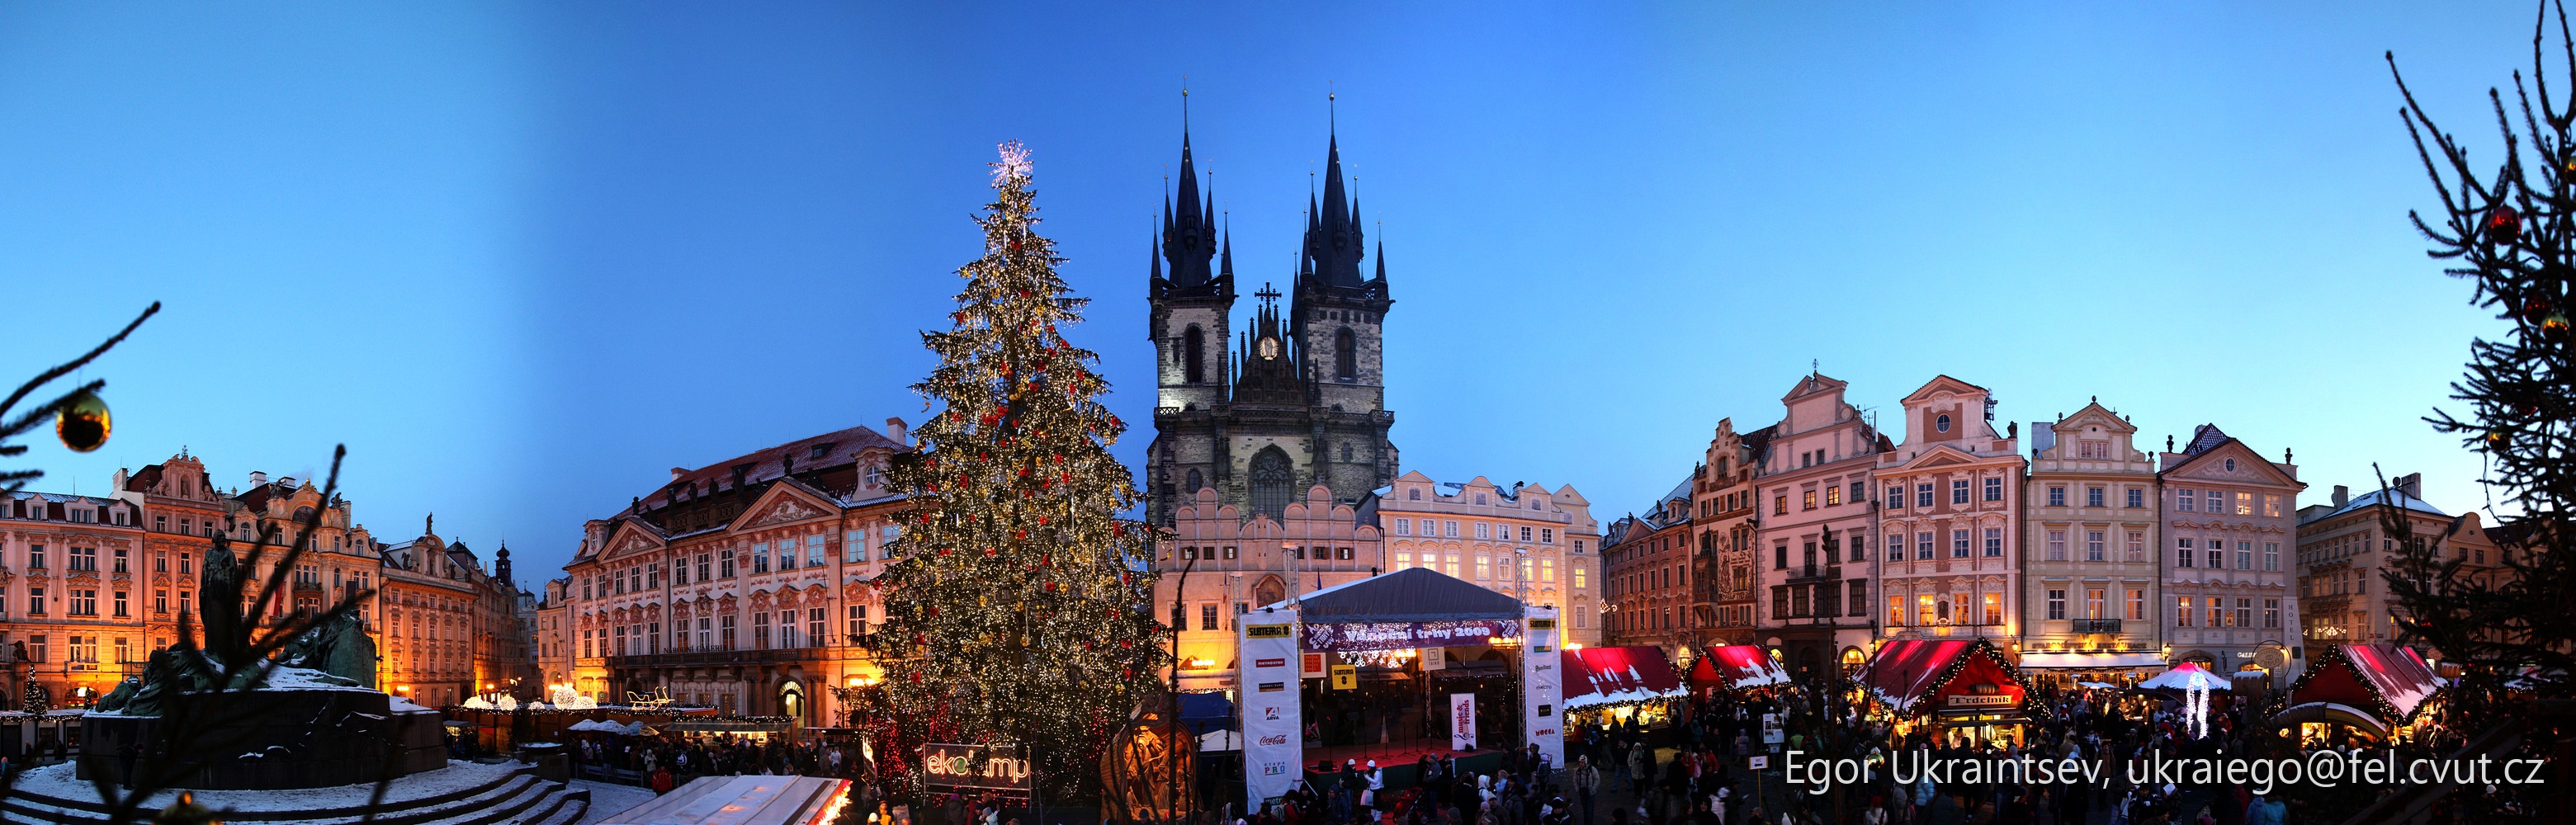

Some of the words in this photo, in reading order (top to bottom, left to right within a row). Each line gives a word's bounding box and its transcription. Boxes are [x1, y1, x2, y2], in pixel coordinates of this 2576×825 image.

[1416, 628, 1452, 639] trhy
[1455, 626, 1491, 637] 2009
[1950, 695, 2010, 705] Trdelník
[1264, 766, 1285, 774] PRO
